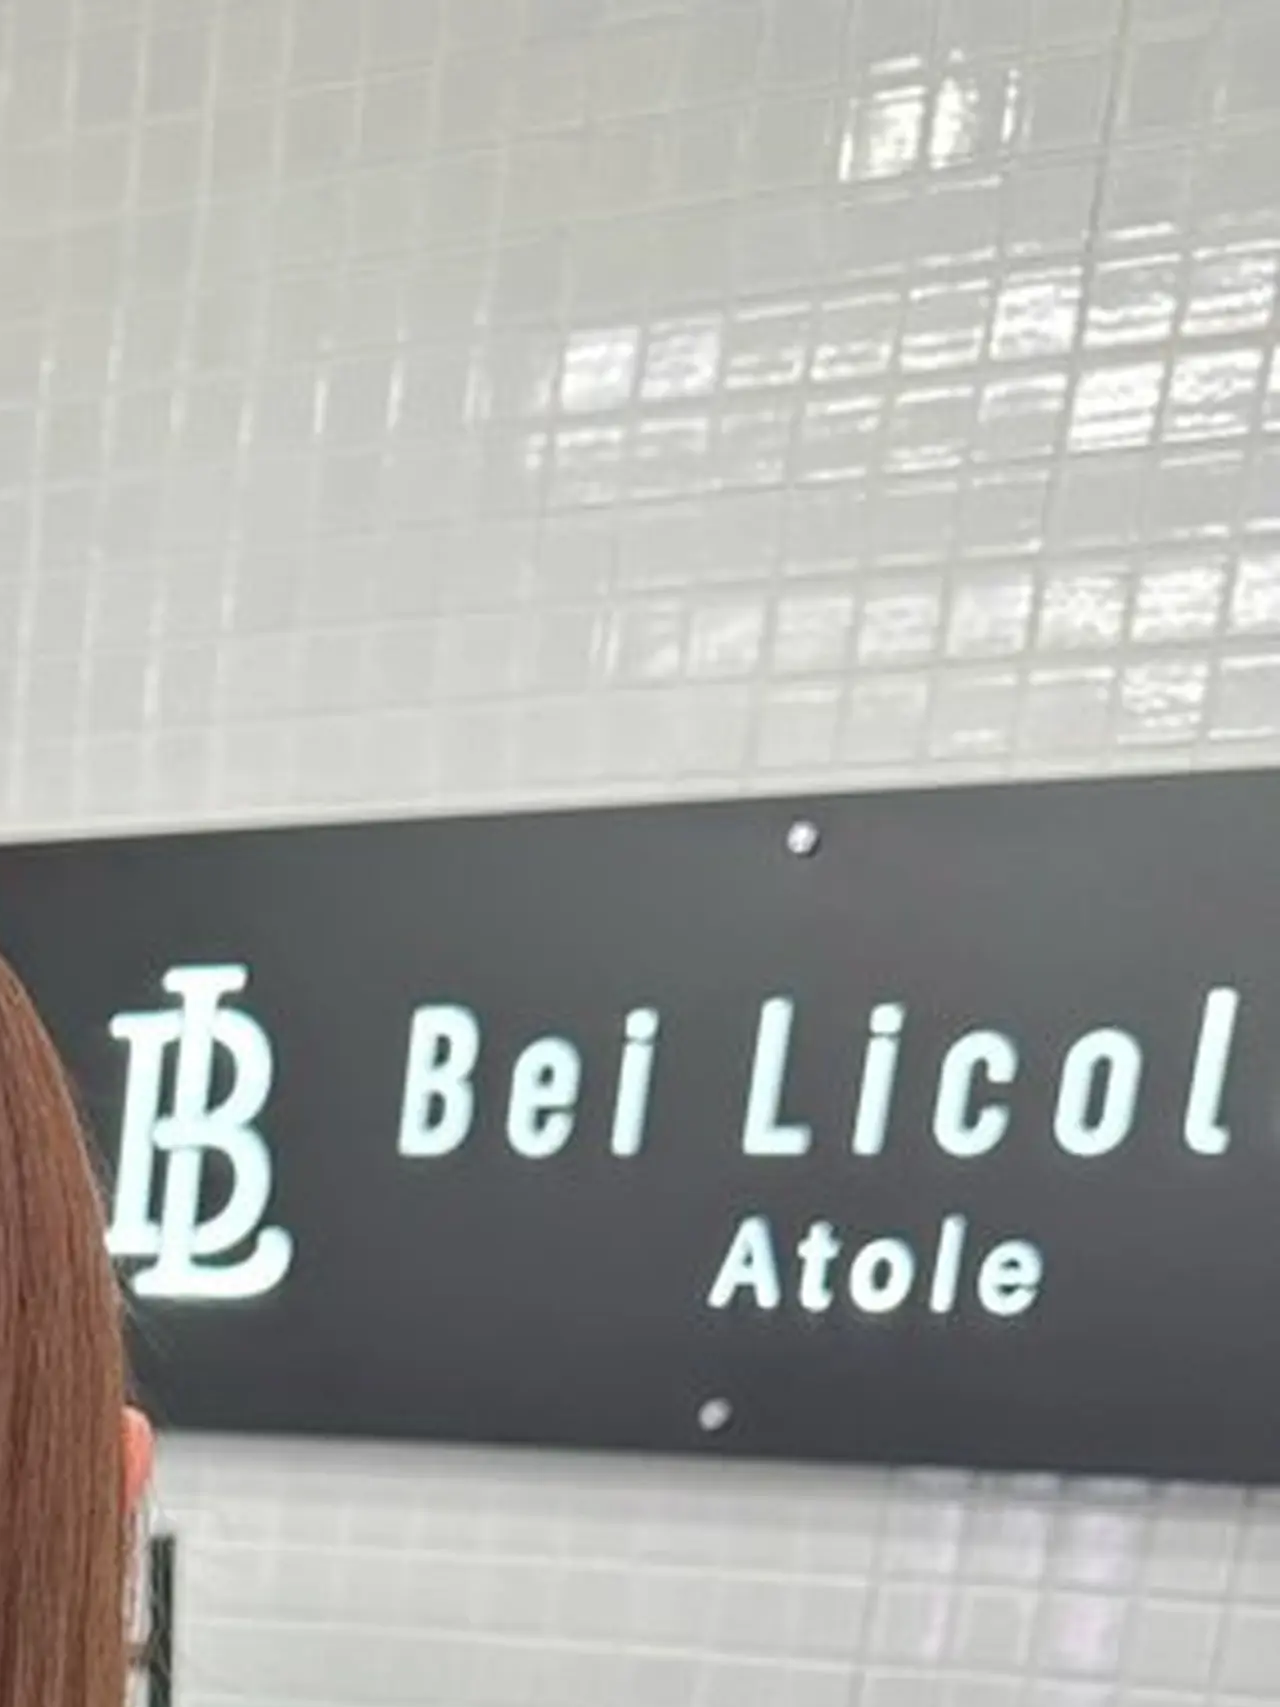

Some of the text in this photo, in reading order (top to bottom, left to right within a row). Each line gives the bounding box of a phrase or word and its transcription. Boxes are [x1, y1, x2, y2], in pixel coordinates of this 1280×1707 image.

[399, 987, 1239, 1158] Bei Licol
[708, 1217, 1042, 1316] Atole
